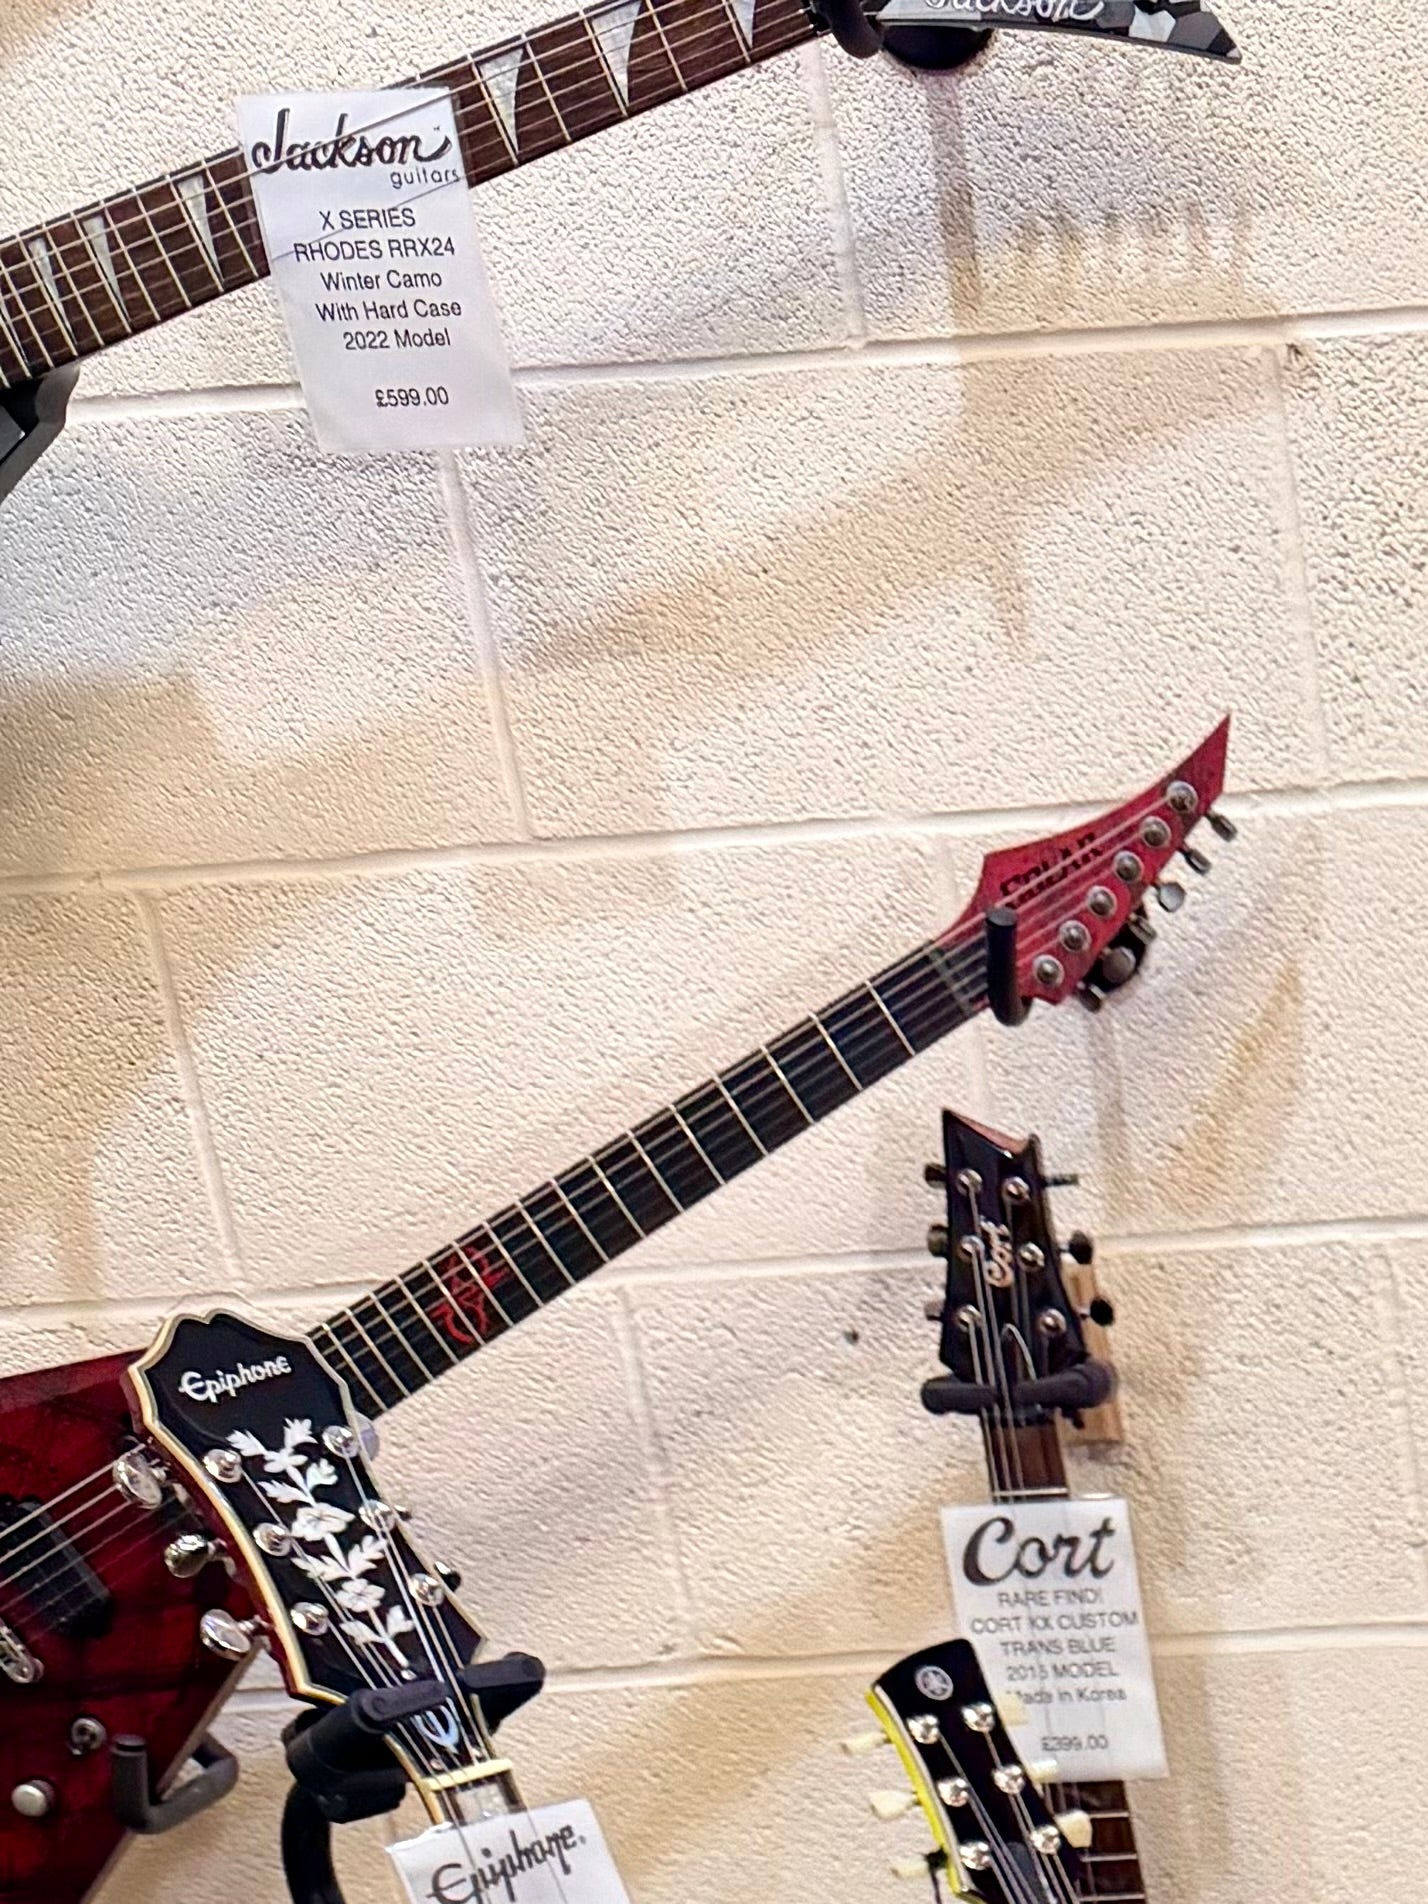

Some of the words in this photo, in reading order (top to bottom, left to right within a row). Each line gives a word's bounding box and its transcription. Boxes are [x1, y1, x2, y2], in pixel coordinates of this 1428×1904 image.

[251, 108, 452, 173] Jackson
[390, 166, 460, 189] guitars
[319, 211, 334, 231] X
[340, 208, 415, 230] SERIES
[293, 241, 382, 263] RHODES
[388, 237, 455, 259] RRX24
[320, 270, 380, 292] Winter
[388, 269, 442, 289] Camo
[314, 302, 359, 322] With
[363, 299, 408, 320] Hard
[413, 298, 462, 318] Case
[343, 331, 388, 350] 2022
[394, 327, 451, 348] Model
[375, 385, 449, 408] £599.00
[178, 1355, 292, 1403] Epiphone
[963, 1516, 1116, 1587] Cort
[998, 1591, 1048, 1608] RARE
[970, 1618, 1021, 1634] CORT
[1058, 1611, 1139, 1630] CUSTOM
[1000, 1640, 1064, 1656] TRANS
[1068, 1637, 1116, 1655] BLUE
[1053, 1662, 1119, 1680] MODEL
[1079, 1687, 1127, 1702] Korea
